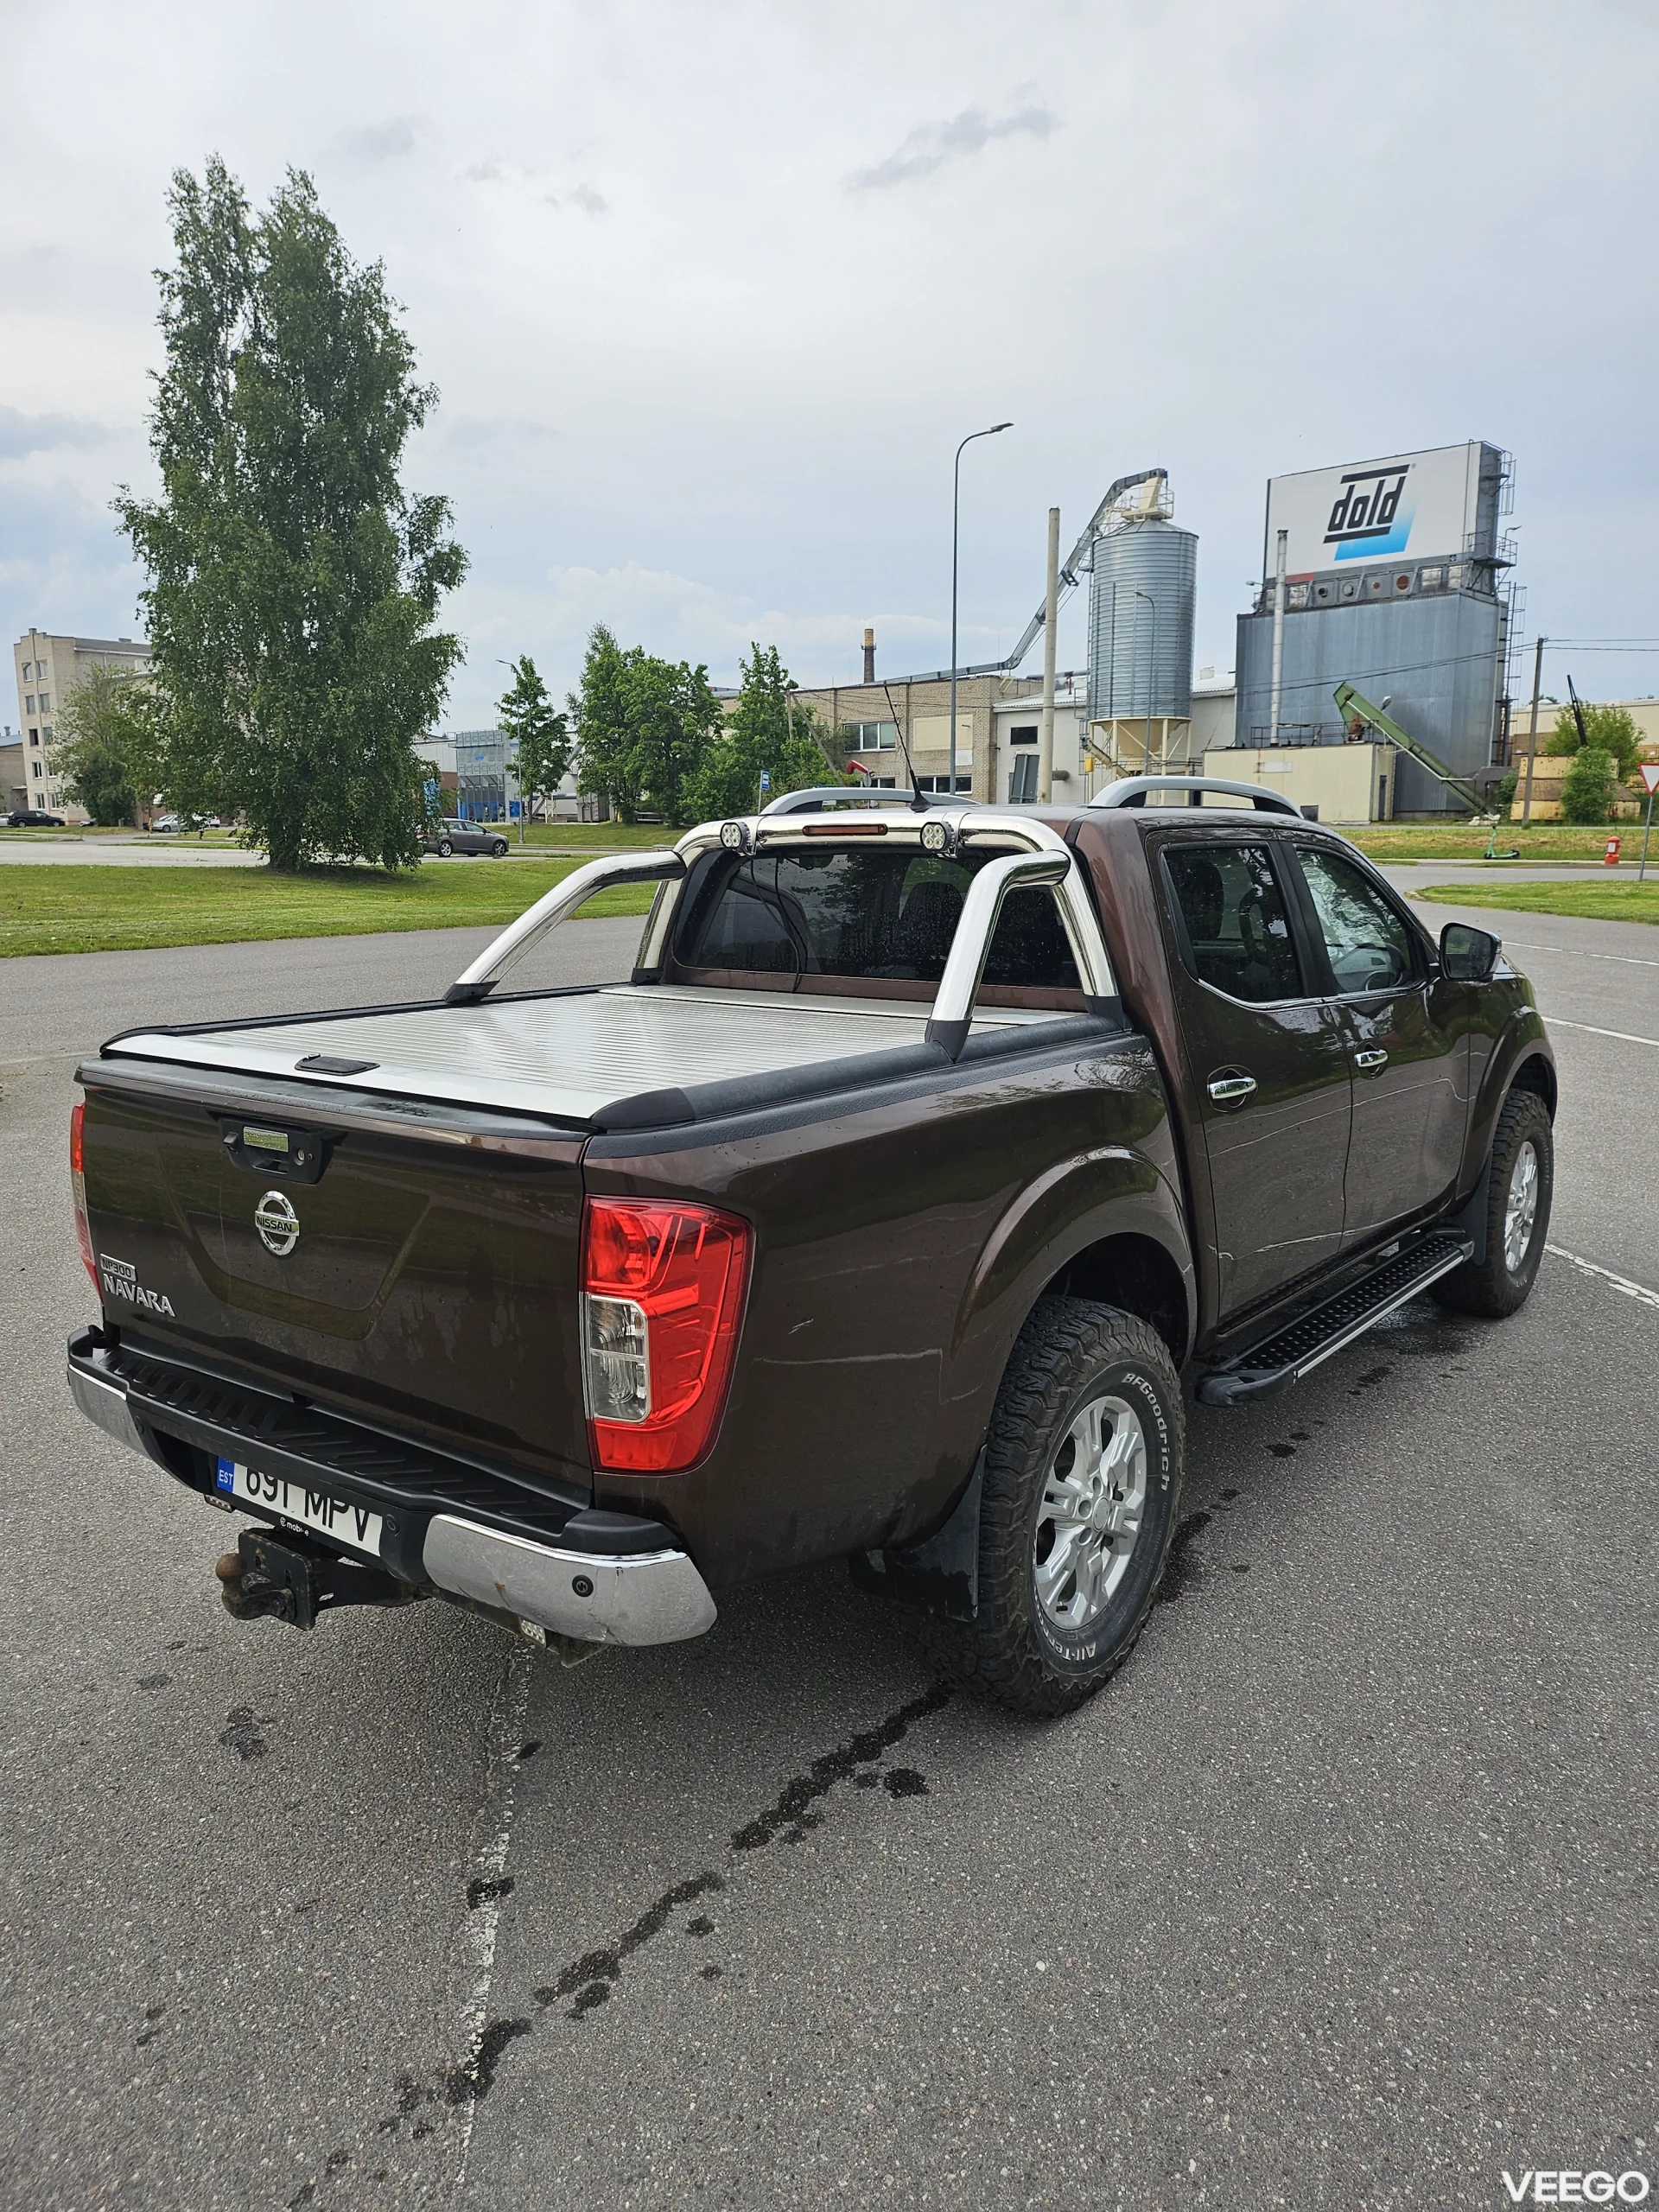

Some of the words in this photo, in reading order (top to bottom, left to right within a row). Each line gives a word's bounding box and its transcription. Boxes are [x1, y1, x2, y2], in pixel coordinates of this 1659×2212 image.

[1327, 476, 1407, 531] dold
[257, 1216, 292, 1232] NISSAN
[102, 1259, 131, 1278] NP300
[104, 1274, 175, 1317] NAVARA
[1122, 1373, 1170, 1491] BFGoodrich
[219, 1470, 234, 1484] EST
[304, 1490, 371, 1541] MPV
